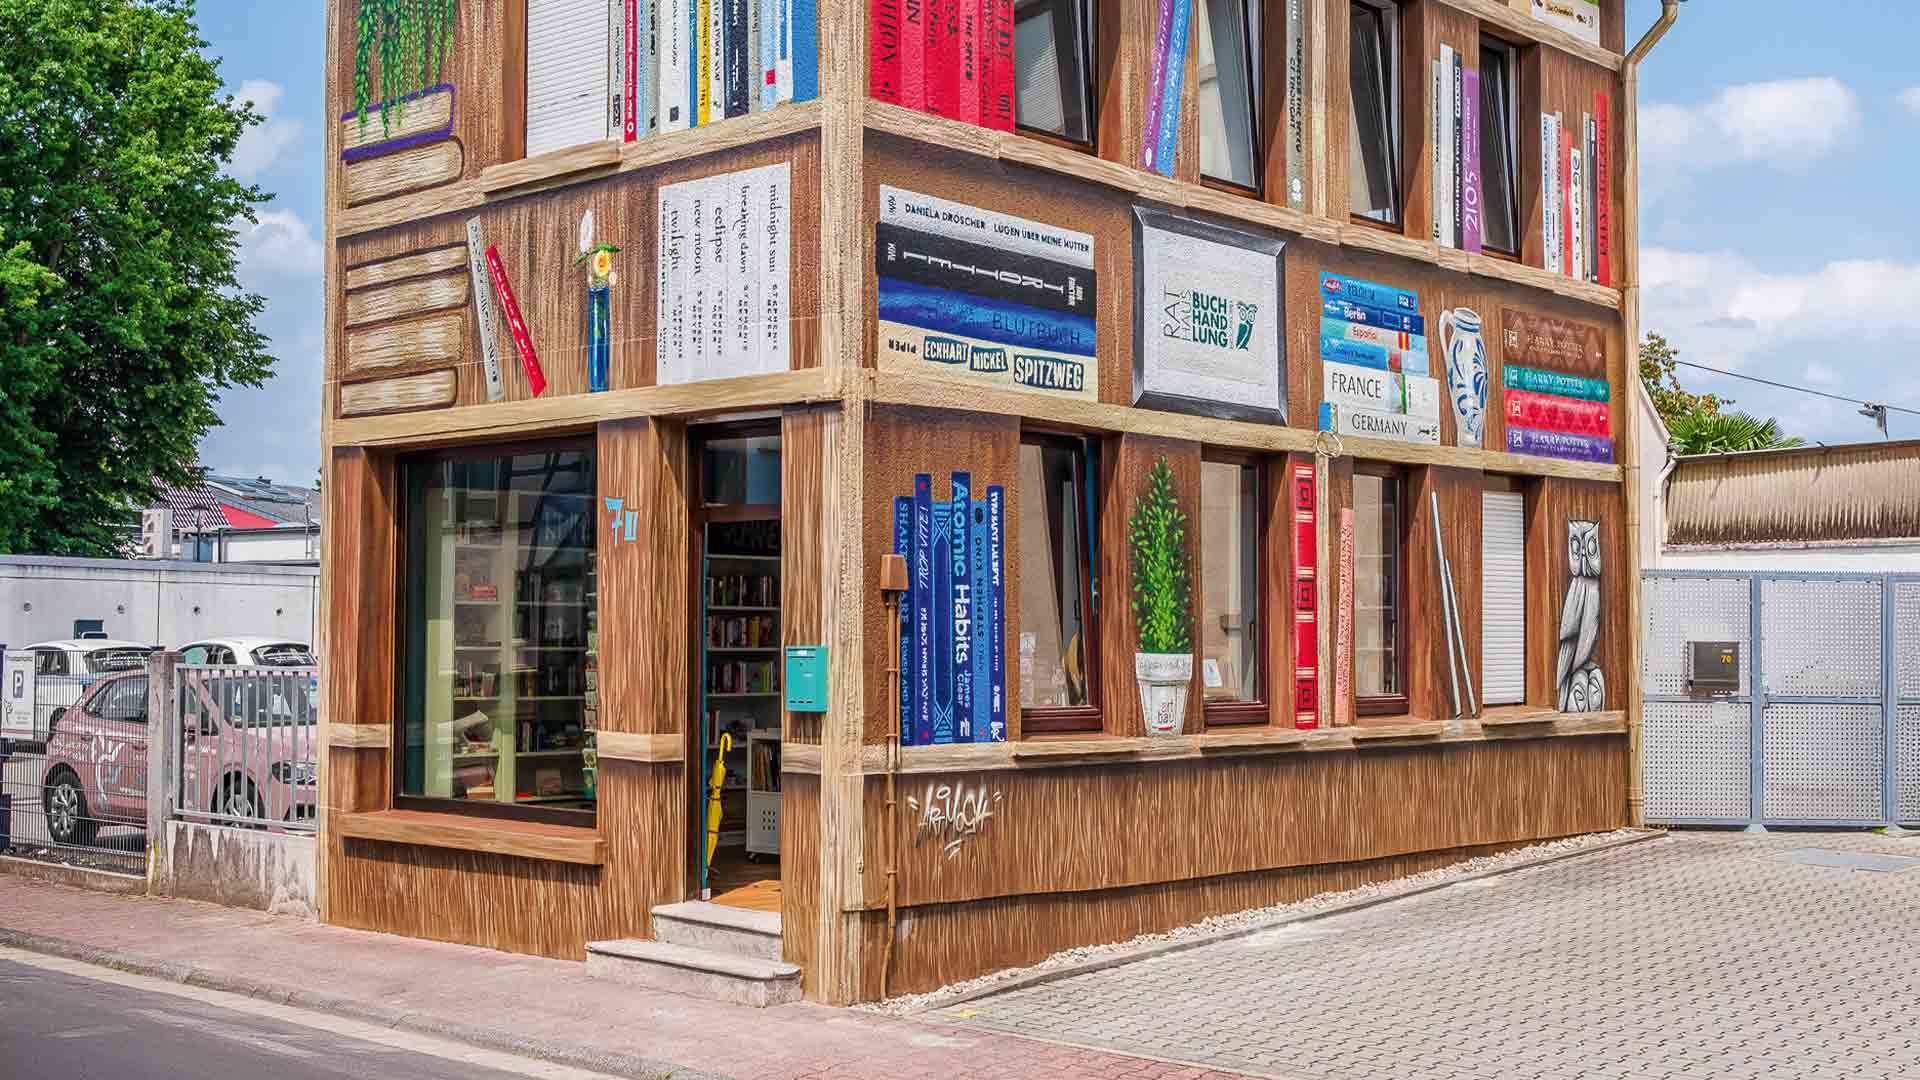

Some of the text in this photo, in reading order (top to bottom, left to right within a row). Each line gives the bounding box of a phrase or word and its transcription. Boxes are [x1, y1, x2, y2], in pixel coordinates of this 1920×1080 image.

[1464, 168, 1478, 233] 2105
[668, 209, 685, 272] twilight
[693, 199, 704, 275] new moon
[708, 207, 726, 263] eclipse
[732, 185, 751, 274] breaking dawn
[767, 184, 782, 273] midnight sun
[904, 203, 940, 220] DANIELA
[1063, 238, 1090, 252] MUTTER
[1192, 291, 1227, 314] BUCH
[1192, 309, 1228, 331] HAND
[1343, 306, 1367, 321] Berlin
[1192, 325, 1228, 348] LUNG
[924, 341, 1084, 390] ECKHART NICKEL SPITZWEG
[1525, 370, 1554, 386] HARRY
[1331, 372, 1382, 399] FRANCE
[1351, 413, 1409, 436] GERMANY
[918, 547, 929, 590] TROP
[953, 480, 971, 664] Atomic Habits
[975, 536, 984, 571] KING
[974, 577, 984, 639] STEPHEN
[900, 634, 910, 675] ROMEO
[1720, 655, 1733, 664] 70
[14, 671, 23, 697] P
[900, 679, 910, 703] AND
[957, 673, 965, 707] Clear
[964, 669, 972, 708] James
[900, 705, 911, 741] JULIET
